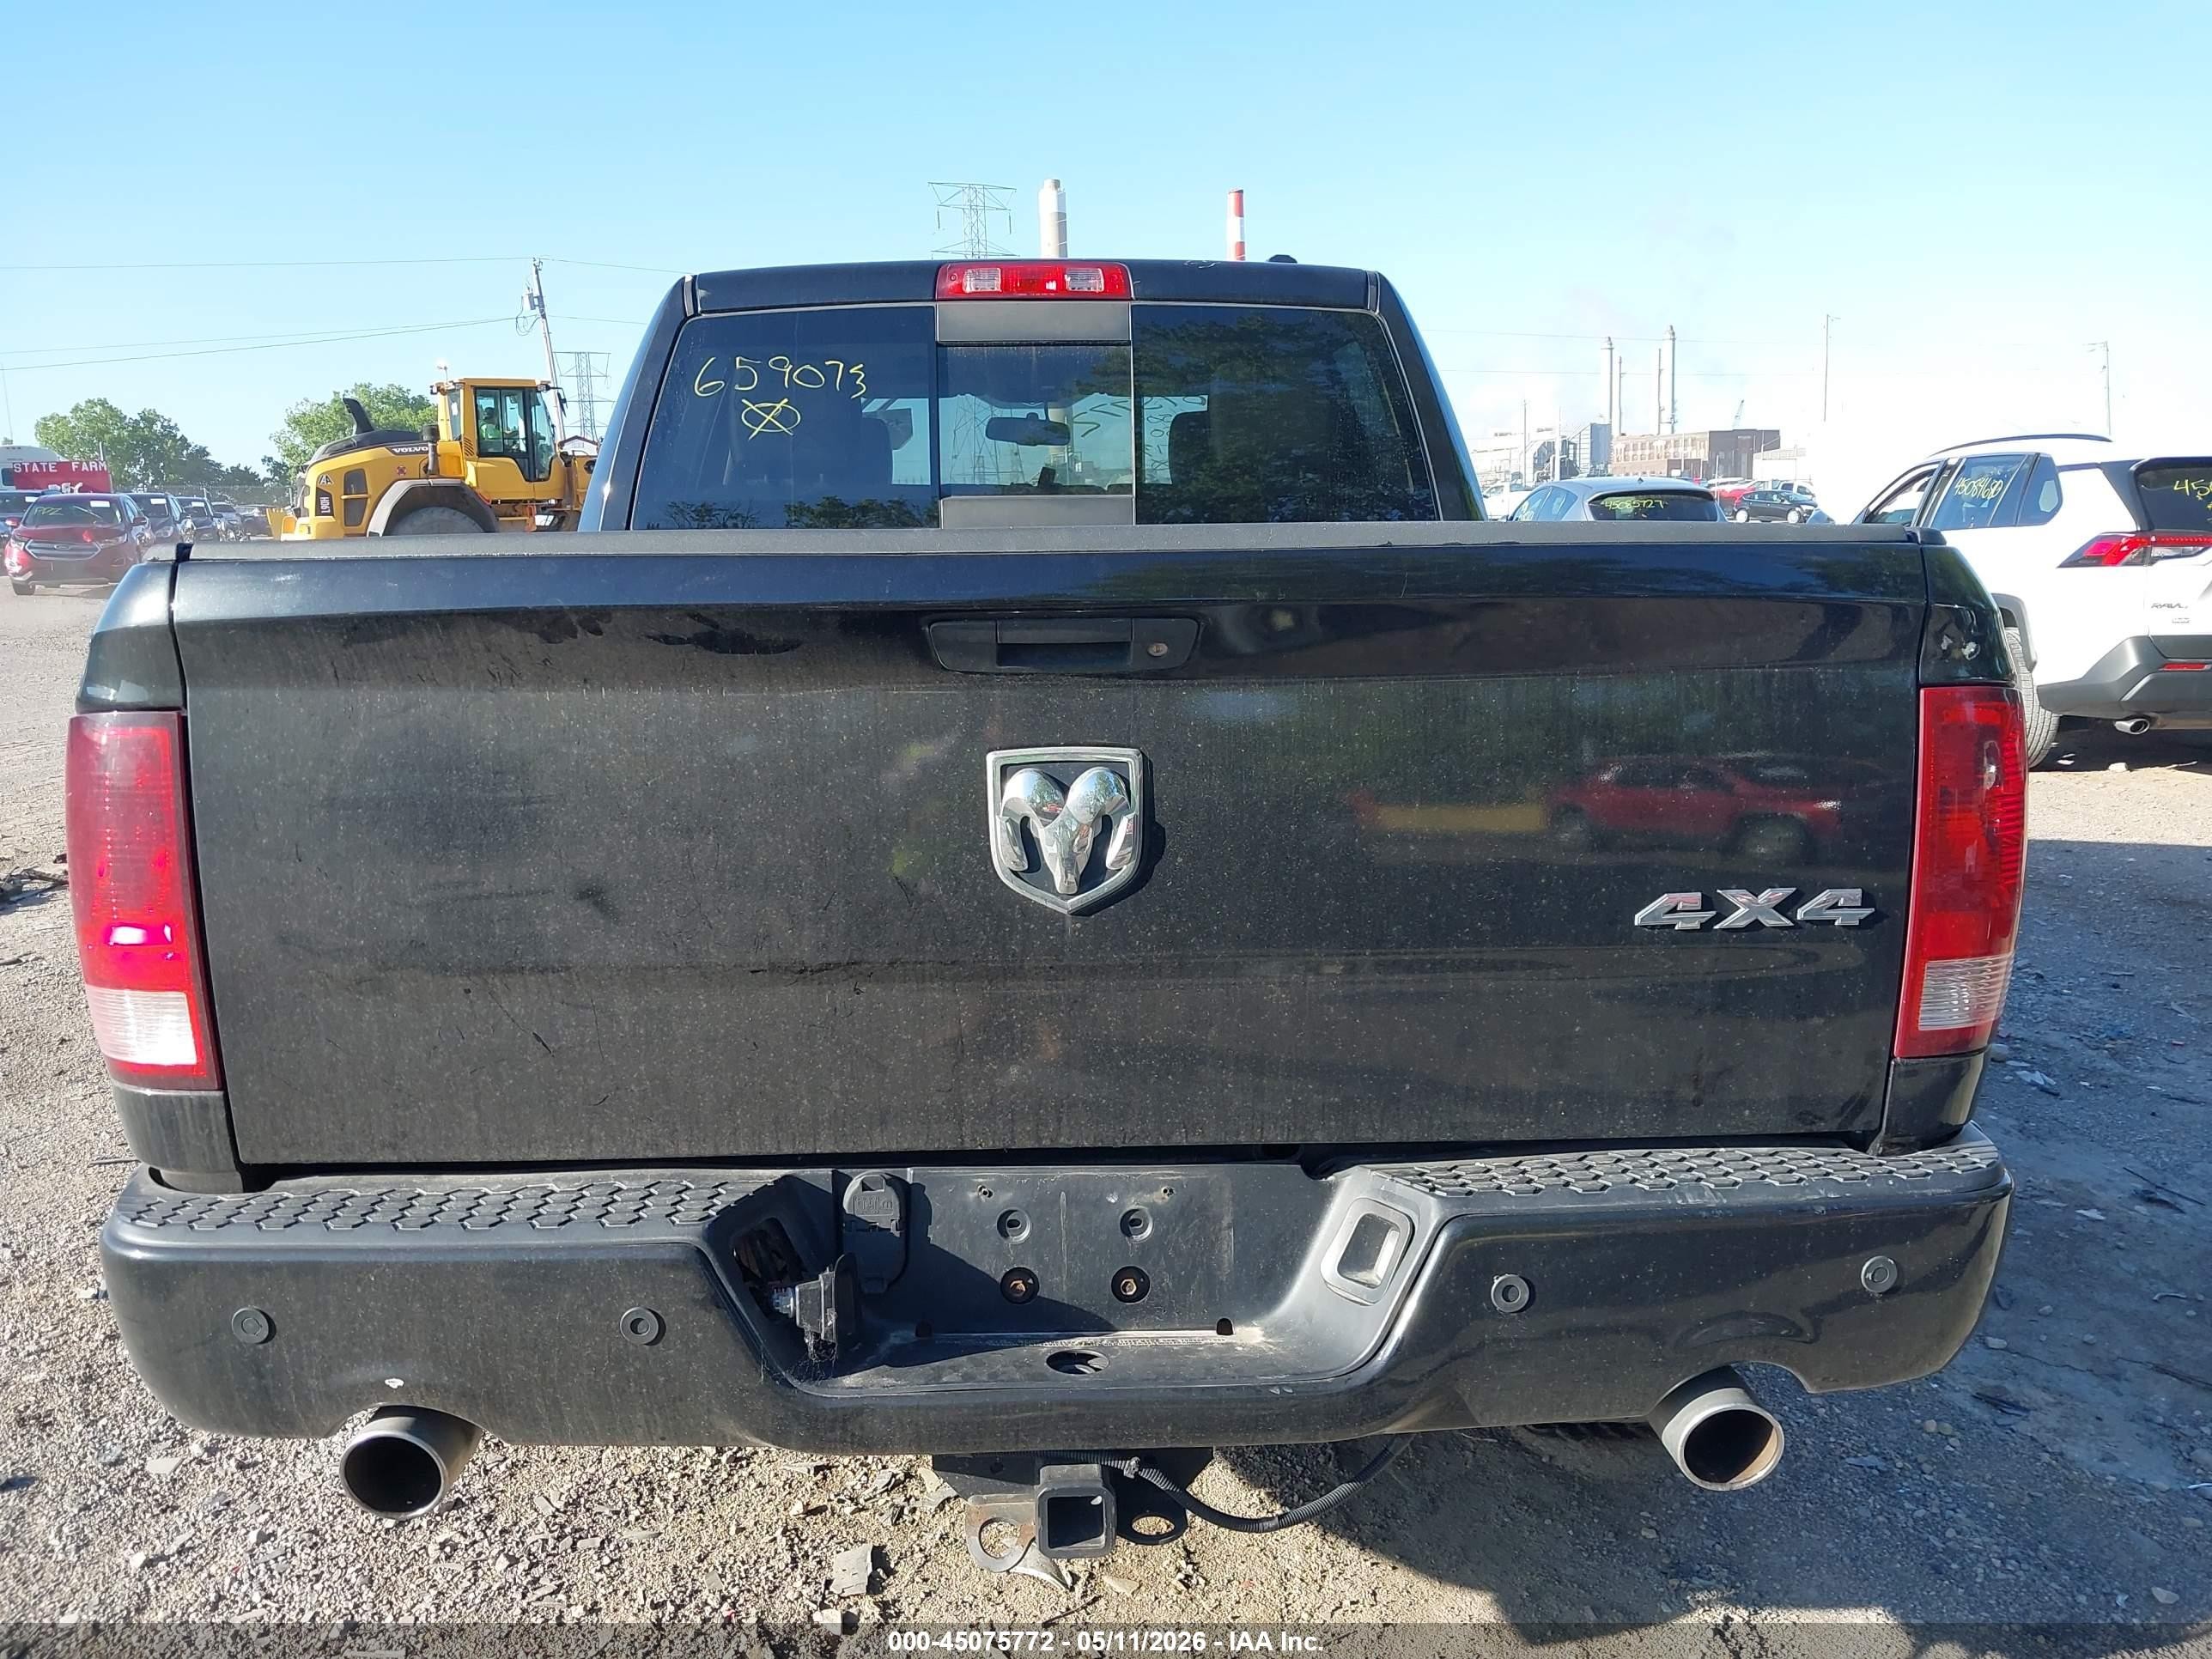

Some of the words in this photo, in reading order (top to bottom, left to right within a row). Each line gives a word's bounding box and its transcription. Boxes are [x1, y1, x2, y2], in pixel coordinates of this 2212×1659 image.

[13, 462, 58, 472] STATE
[71, 460, 107, 472] FARM
[2172, 478, 2212, 496] 45
